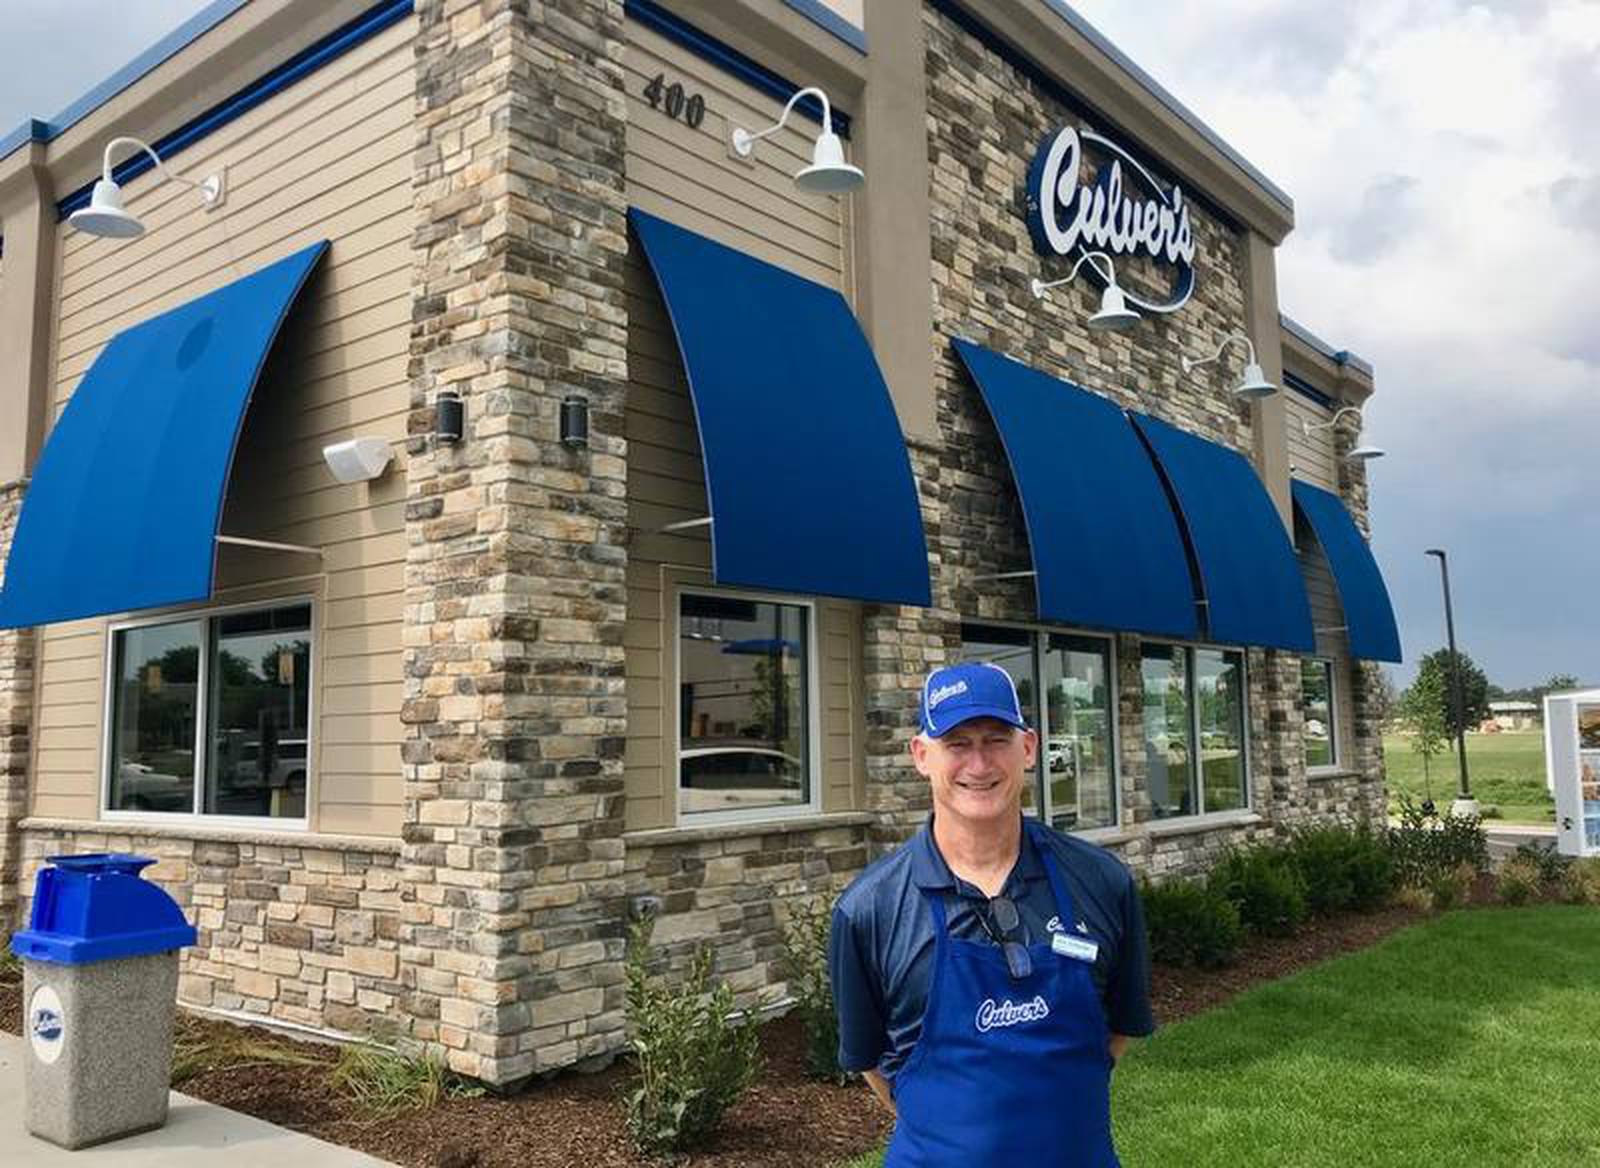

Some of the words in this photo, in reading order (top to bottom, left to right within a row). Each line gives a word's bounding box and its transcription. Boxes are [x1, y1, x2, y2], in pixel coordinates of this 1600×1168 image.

[643, 73, 705, 129] 400
[1040, 126, 1196, 267] Culver's
[976, 995, 1050, 1033] Culver's
